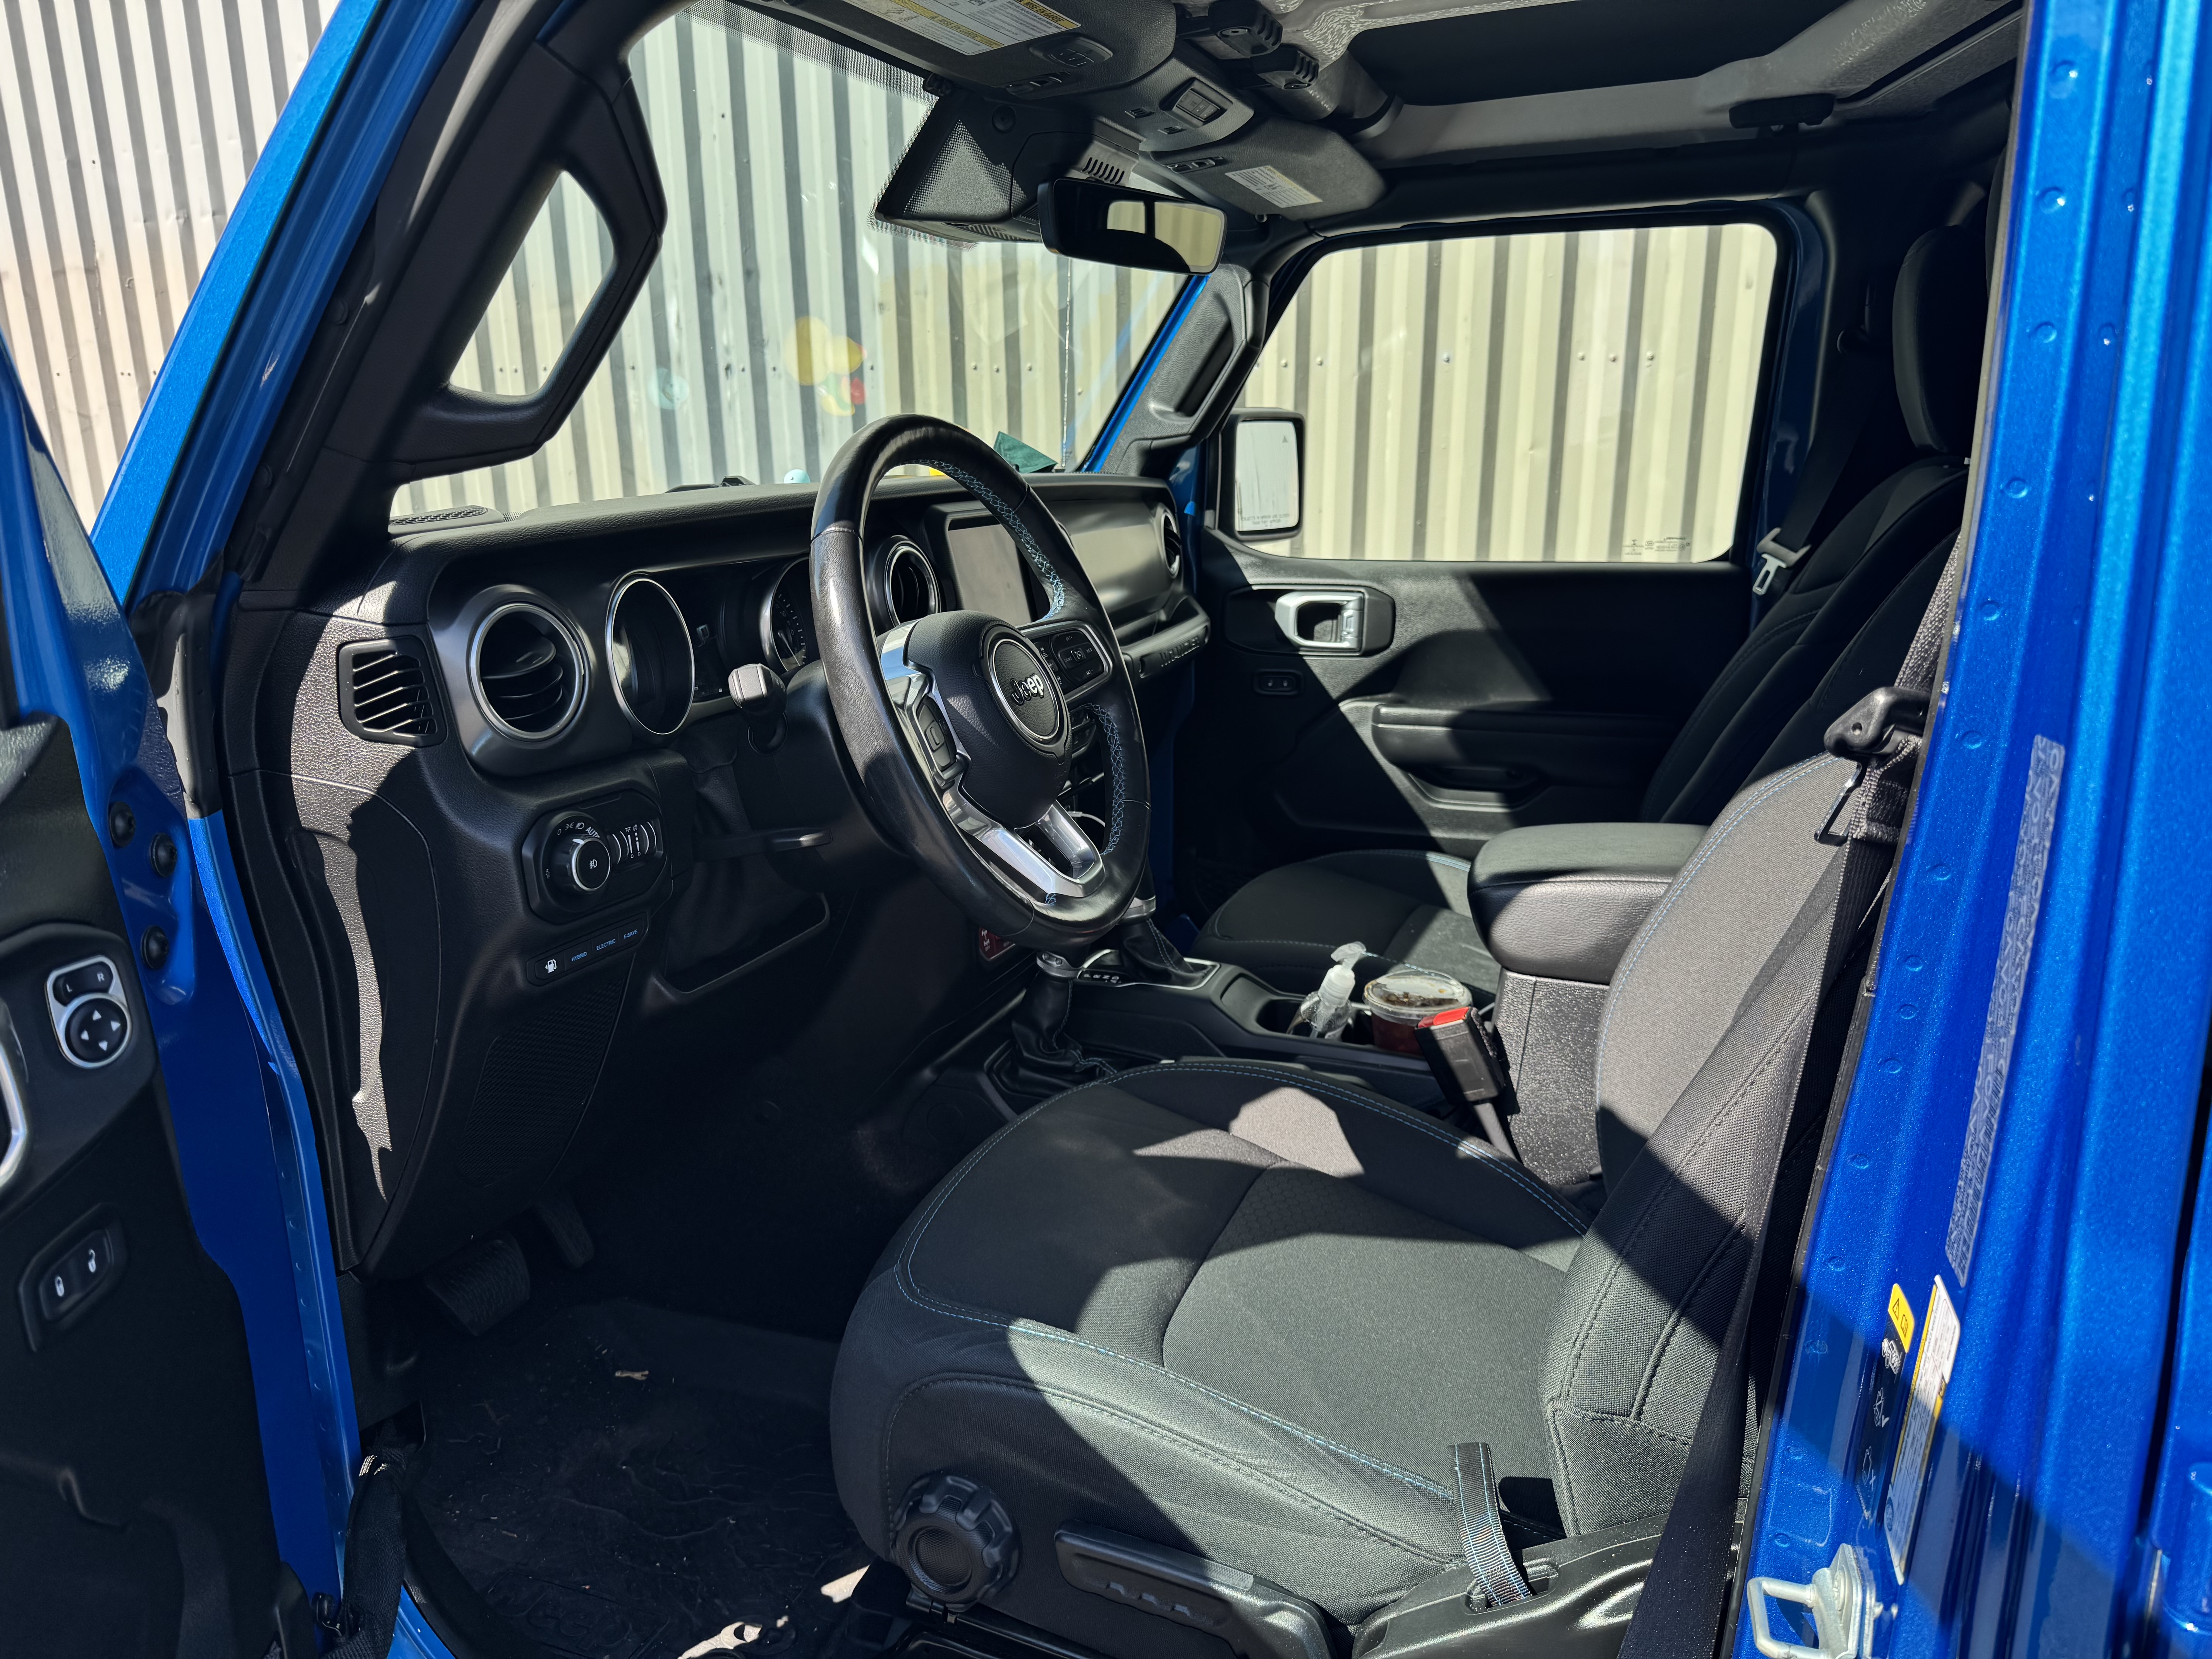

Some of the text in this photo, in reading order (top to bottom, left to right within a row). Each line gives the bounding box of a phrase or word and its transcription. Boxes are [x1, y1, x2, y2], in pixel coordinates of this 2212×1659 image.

[1045, 10, 1064, 23] GARDE
[1010, 673, 1045, 706] Jeep
[623, 929, 638, 939] E-SAVE
[596, 939, 616, 951] ELECTRIC
[571, 951, 587, 962] HYBRID
[97, 972, 105, 982] R
[66, 984, 72, 992] L
